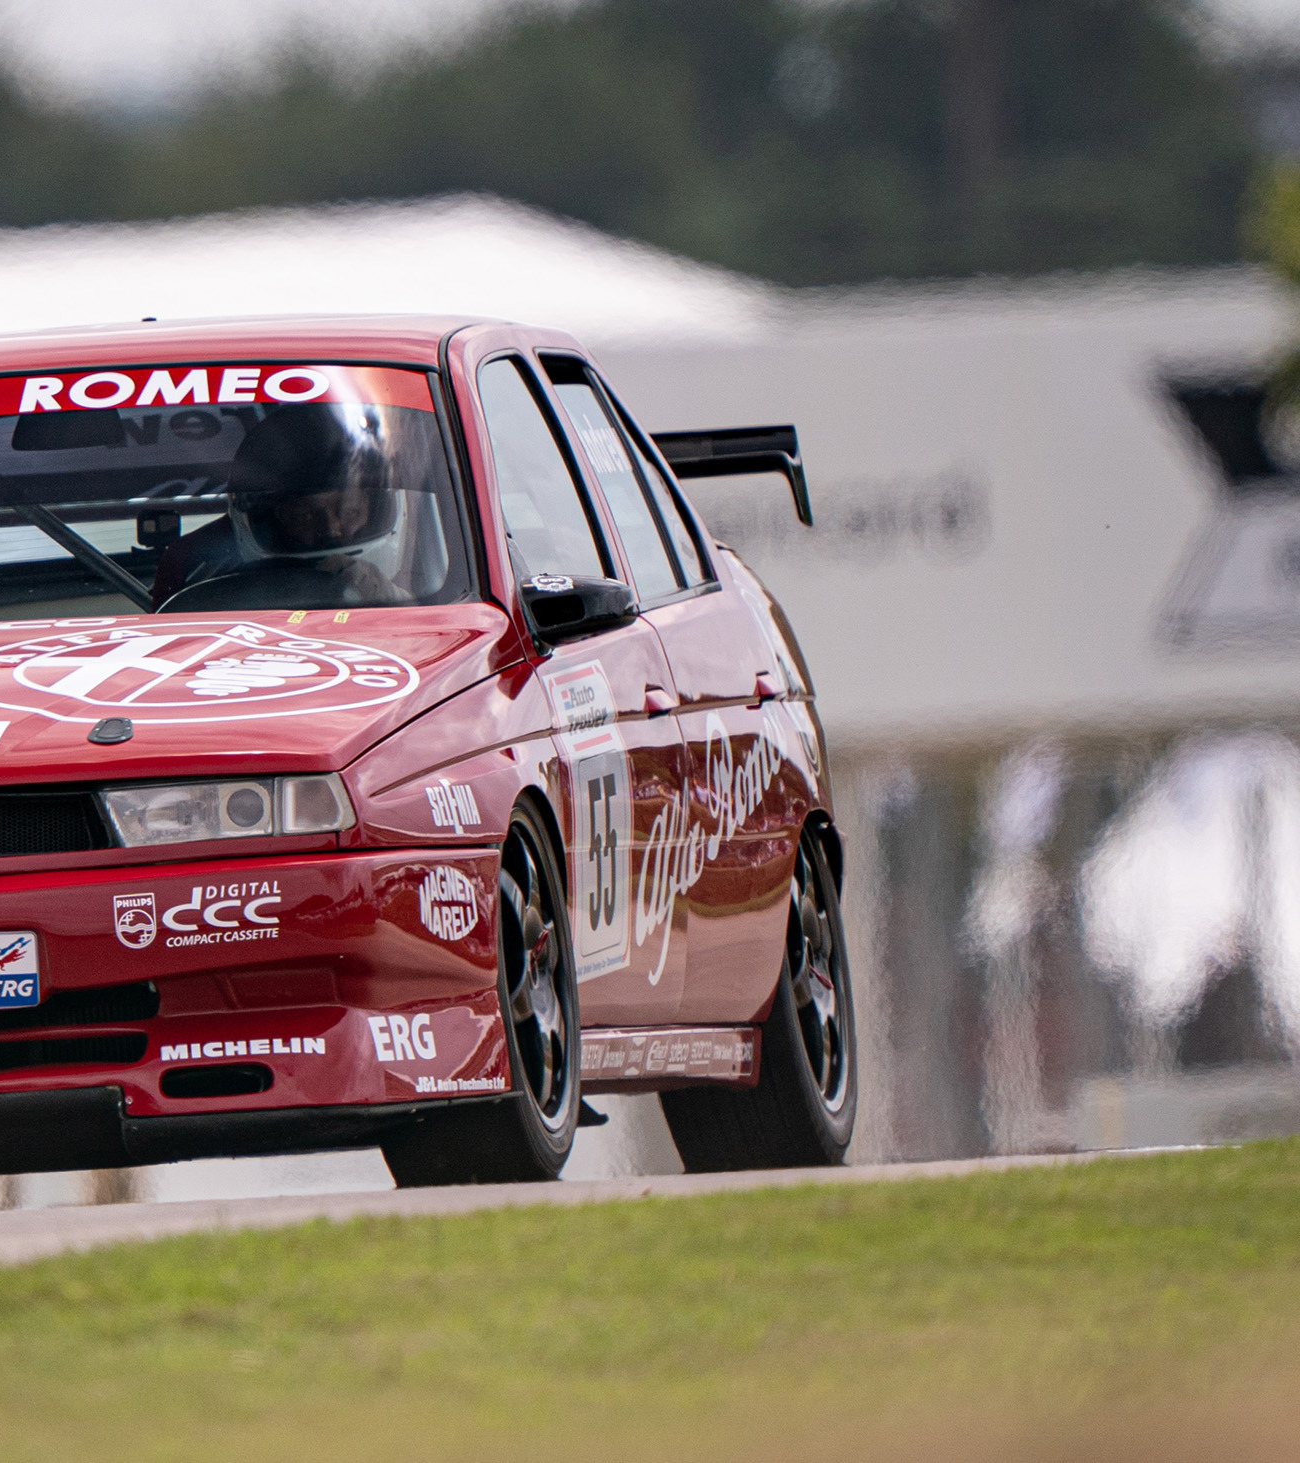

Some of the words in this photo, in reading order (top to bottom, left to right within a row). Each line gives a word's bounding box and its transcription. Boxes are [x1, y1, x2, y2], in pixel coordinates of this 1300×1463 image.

[19, 368, 330, 412] ROMEO
[225, 624, 400, 689] ROMEO
[568, 685, 595, 708] Auto
[425, 778, 482, 835] SELENIA
[587, 772, 617, 932] 55
[115, 897, 153, 909] PHILIPS
[161, 887, 281, 931] dcc
[205, 880, 281, 900] DIGITAL
[165, 932, 223, 949] COMPACT
[224, 928, 279, 944] CASSETTE
[161, 1037, 326, 1061] MICHELIN
[367, 1013, 436, 1062] ERG
